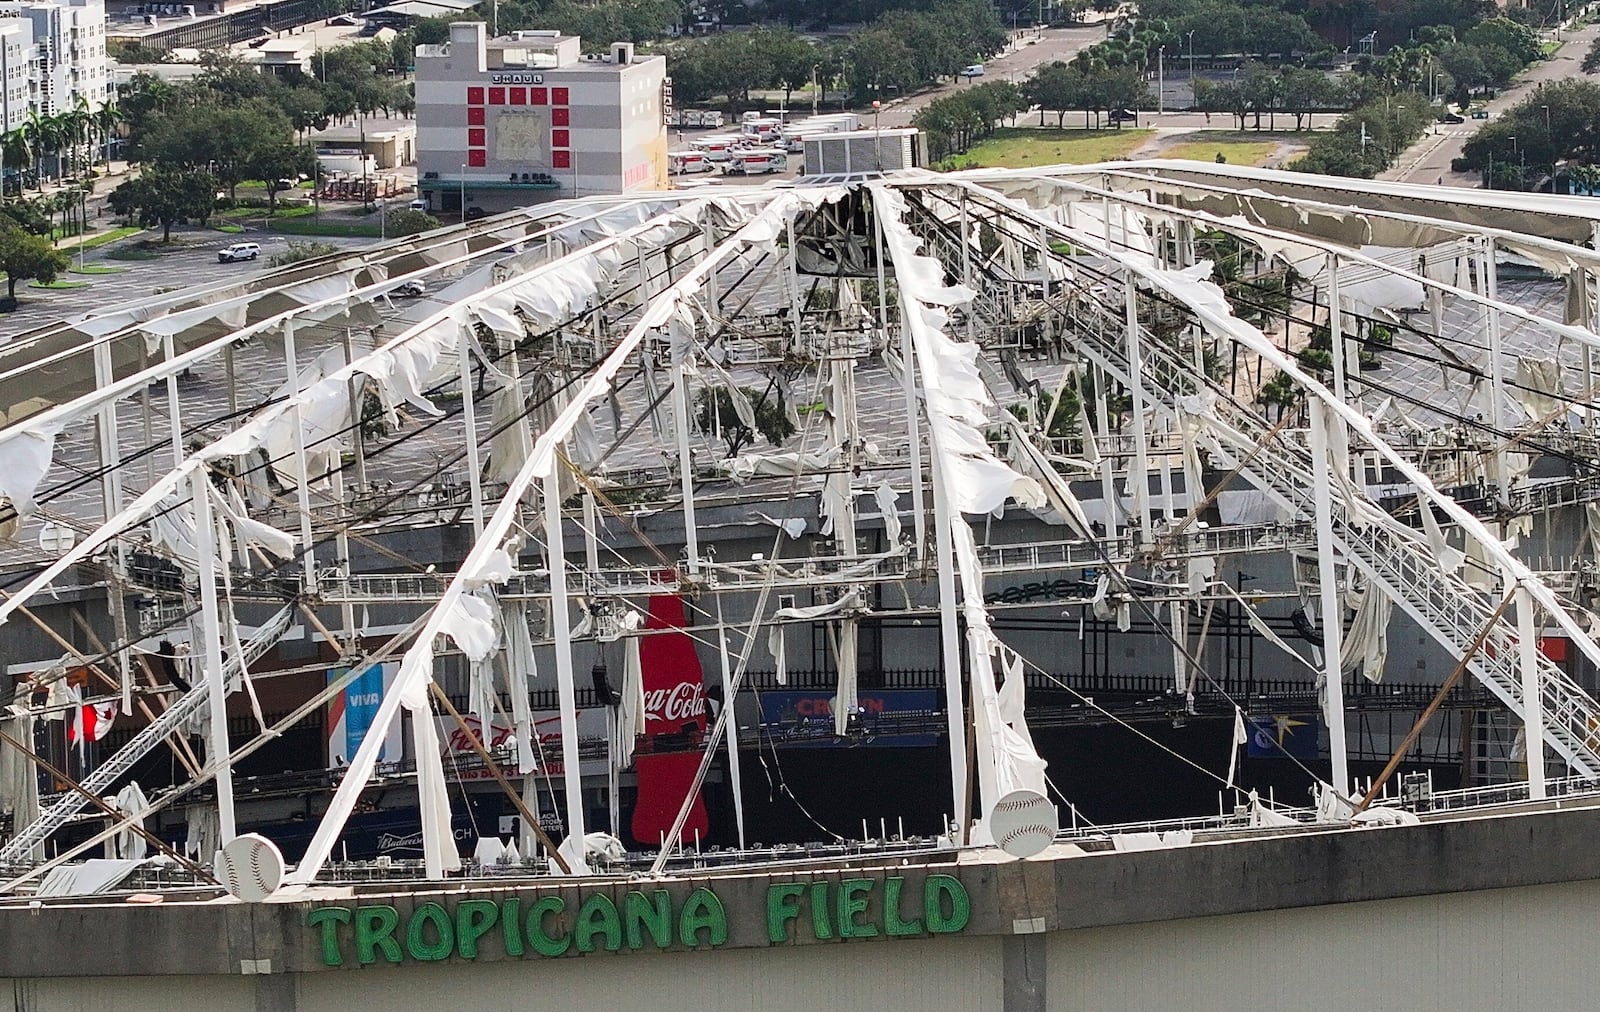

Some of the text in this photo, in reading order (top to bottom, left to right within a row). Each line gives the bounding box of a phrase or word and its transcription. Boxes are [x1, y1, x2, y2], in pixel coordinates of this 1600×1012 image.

[349, 692, 380, 707] VIVA
[308, 874, 970, 966] TROPICANA FIELD
